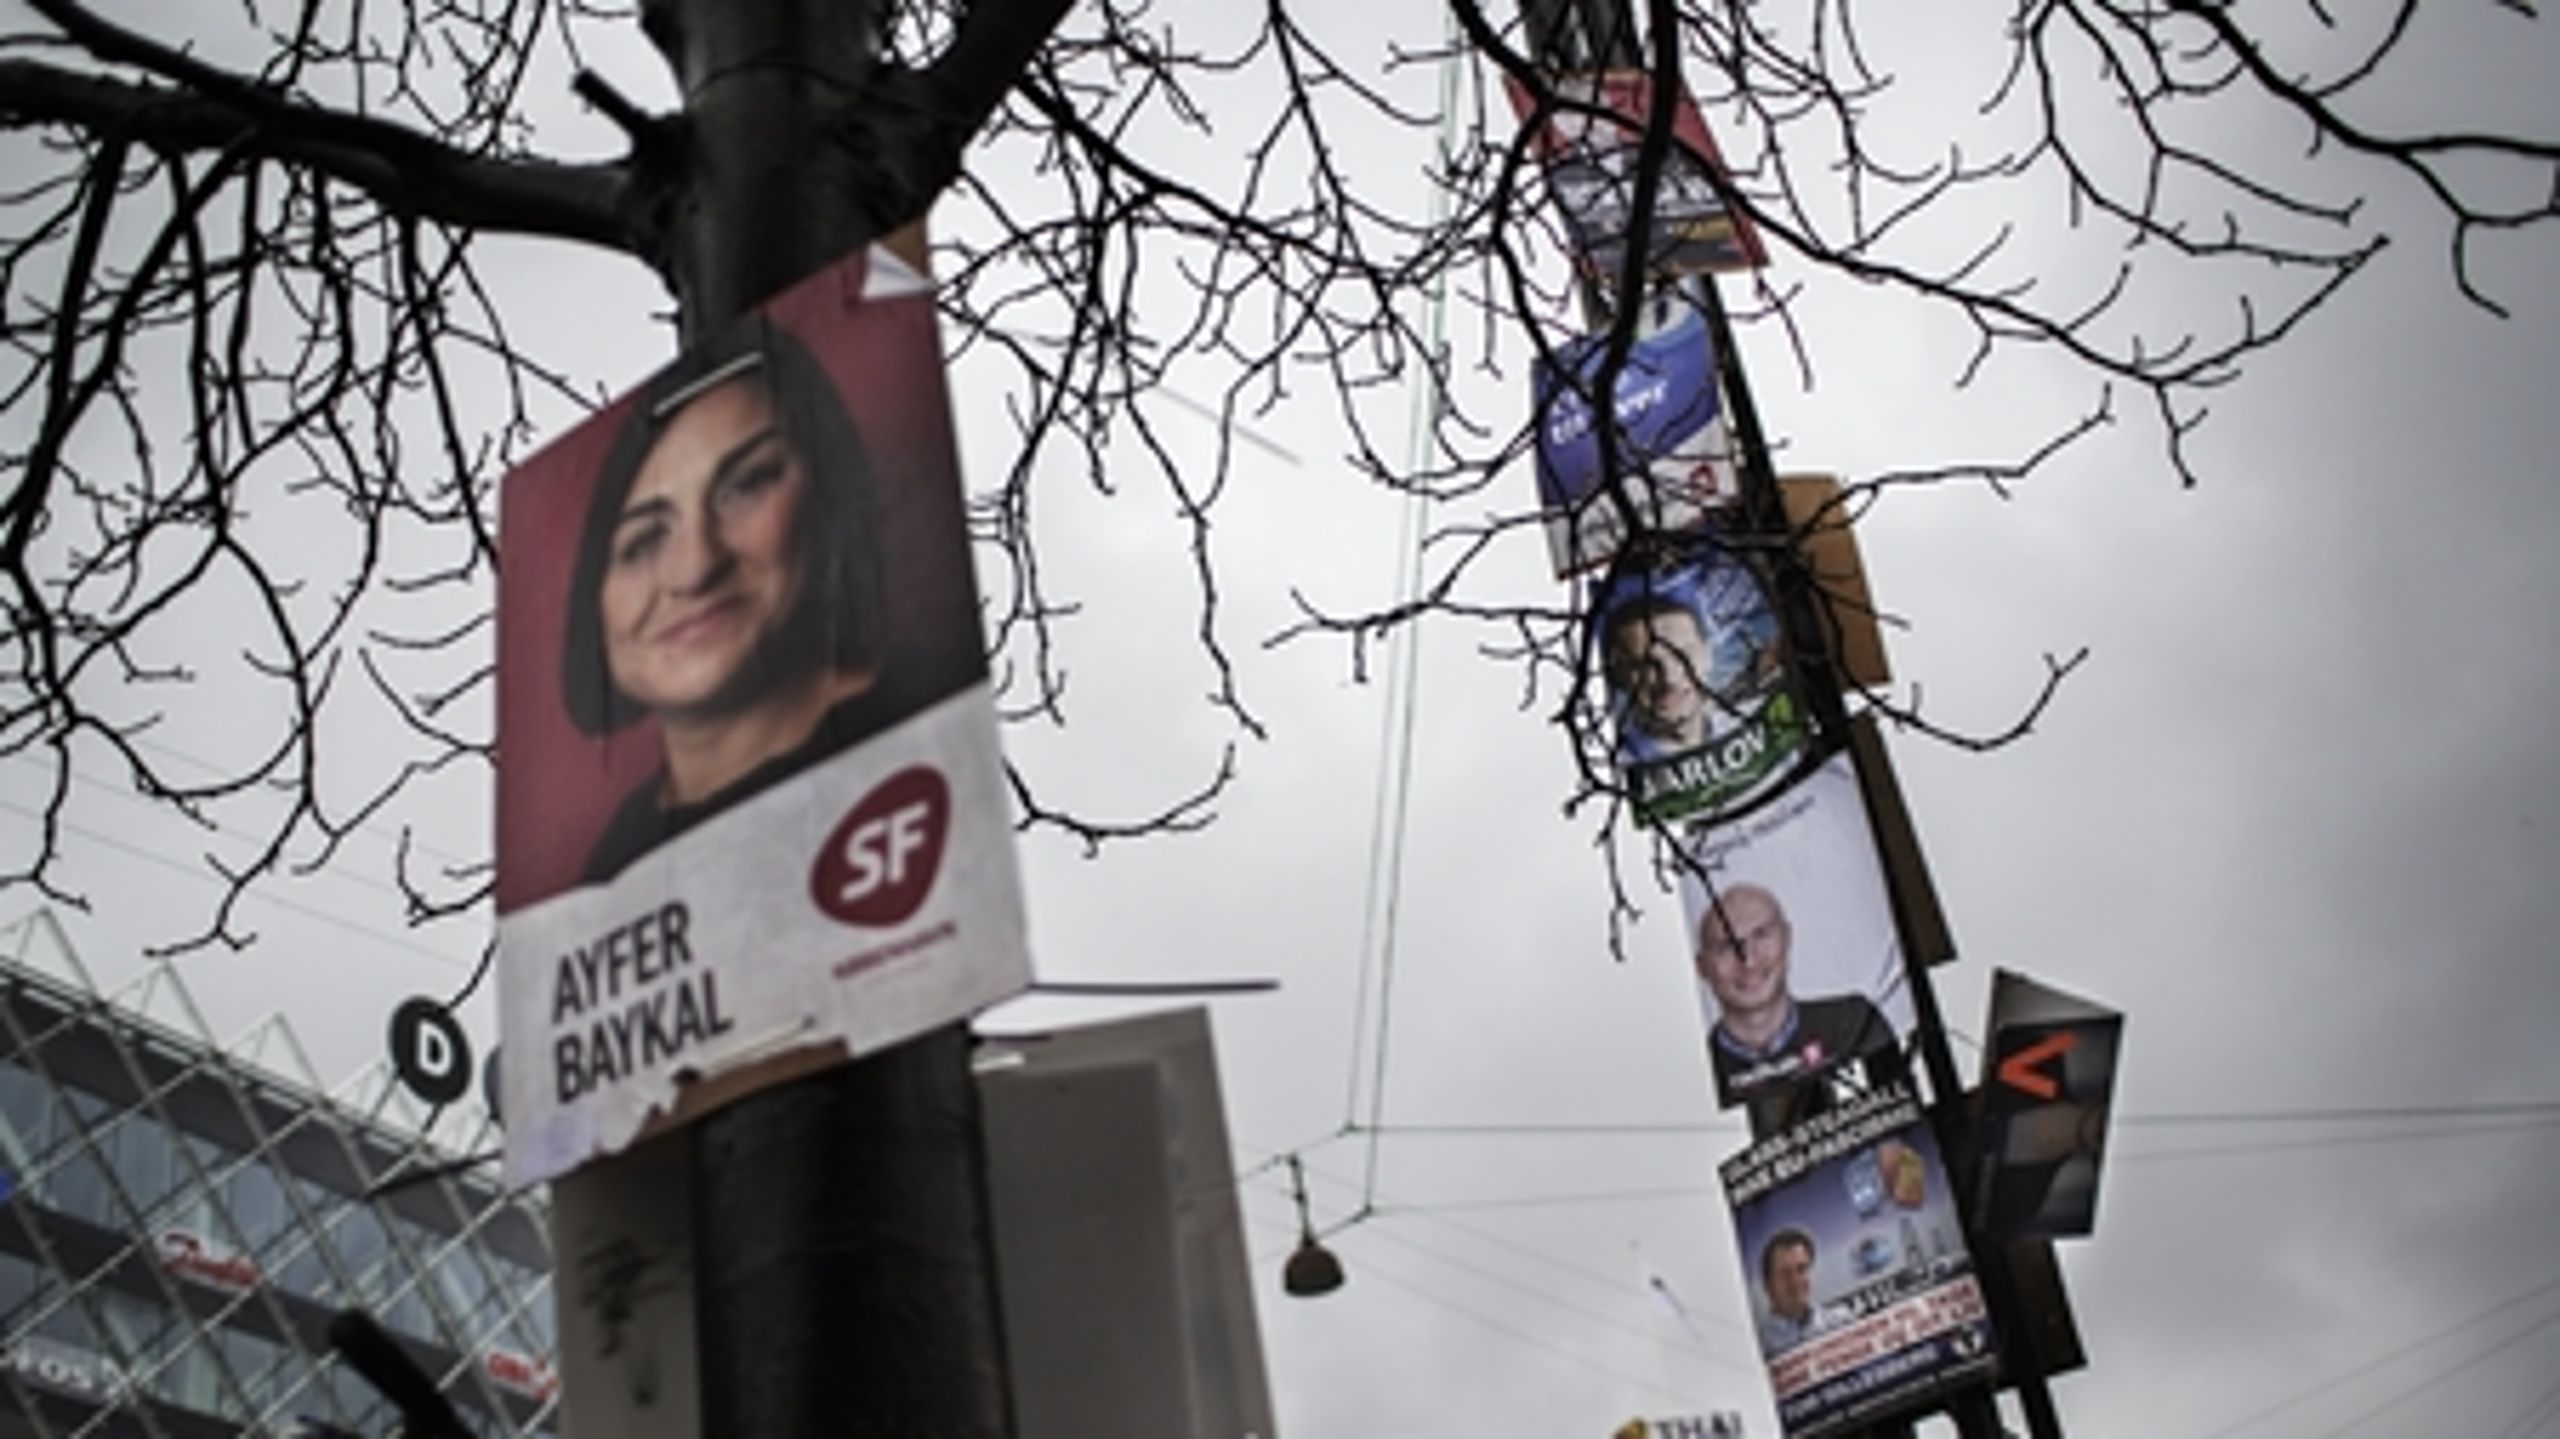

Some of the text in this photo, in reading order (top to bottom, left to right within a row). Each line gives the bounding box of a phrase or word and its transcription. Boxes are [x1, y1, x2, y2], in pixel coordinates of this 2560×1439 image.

[840, 800, 930, 902] SF
[551, 901, 693, 1025] AYFER
[416, 1018, 453, 1074] D
[554, 968, 735, 1104] BAYKAL
